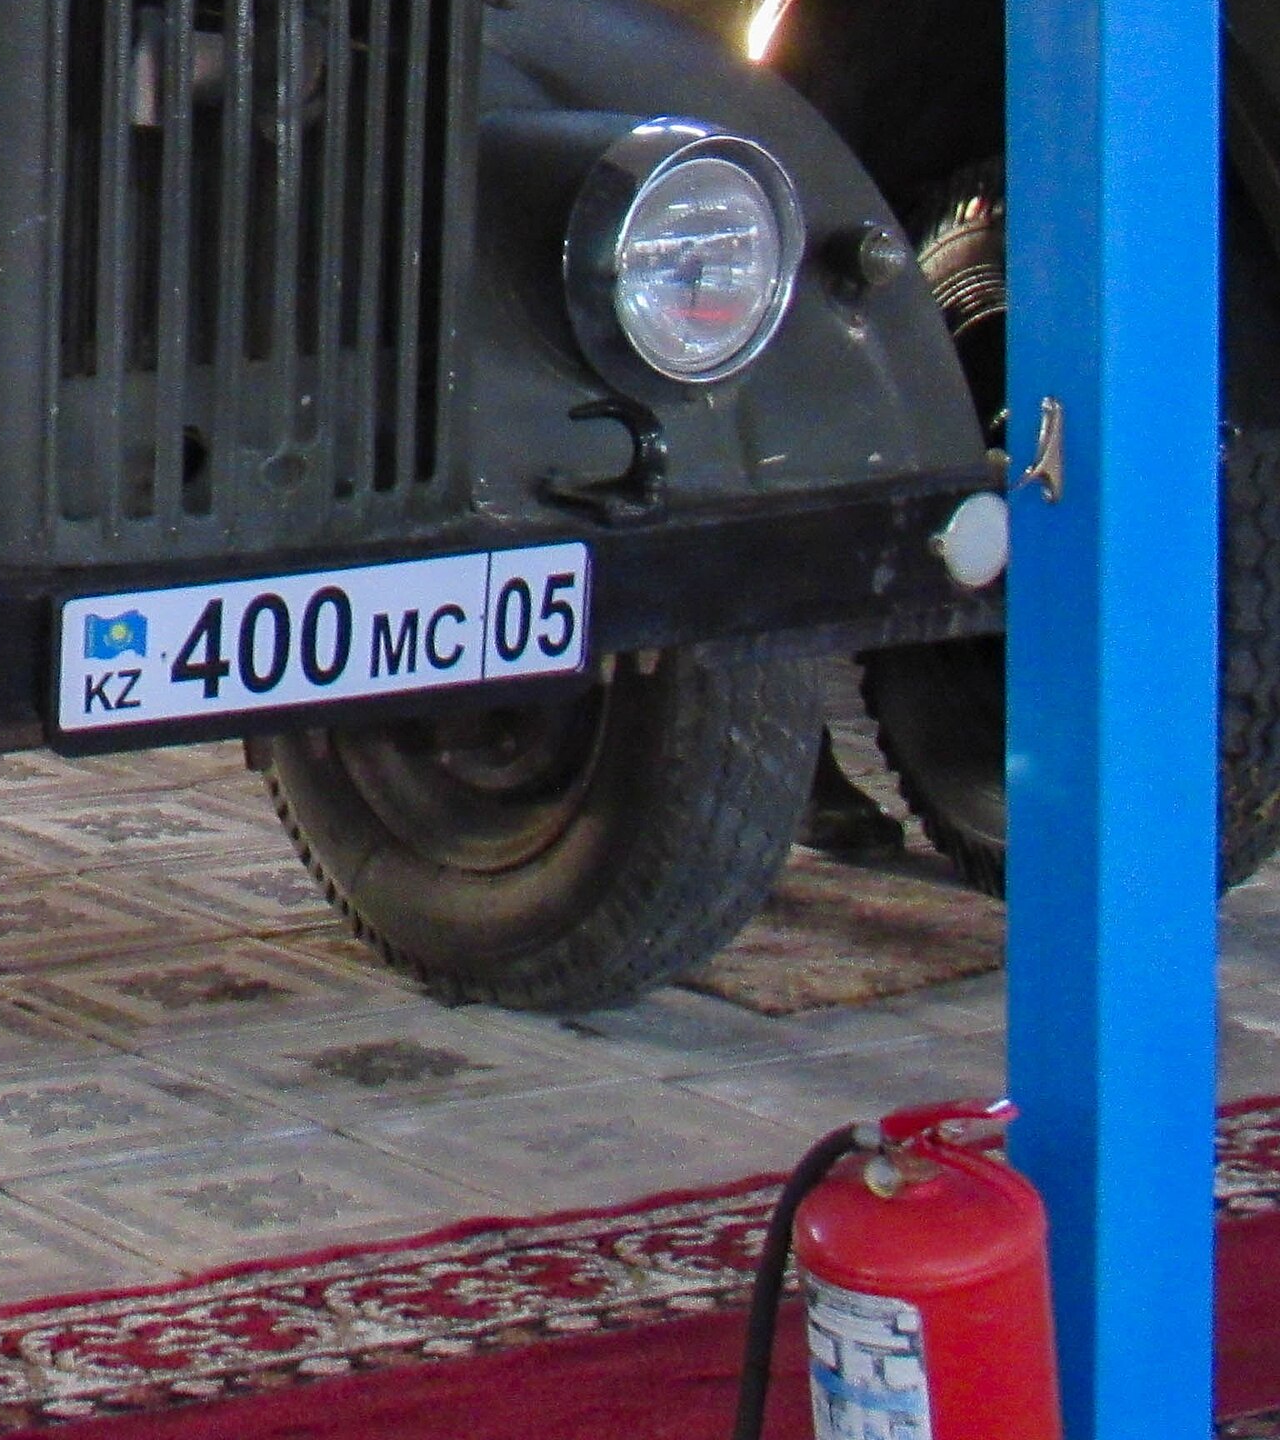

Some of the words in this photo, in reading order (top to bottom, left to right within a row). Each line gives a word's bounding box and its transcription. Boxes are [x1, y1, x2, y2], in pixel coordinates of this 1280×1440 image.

[83, 667, 142, 714] KZ
[169, 585, 354, 700] 400
[369, 601, 467, 679] MC
[493, 572, 577, 662] 05
